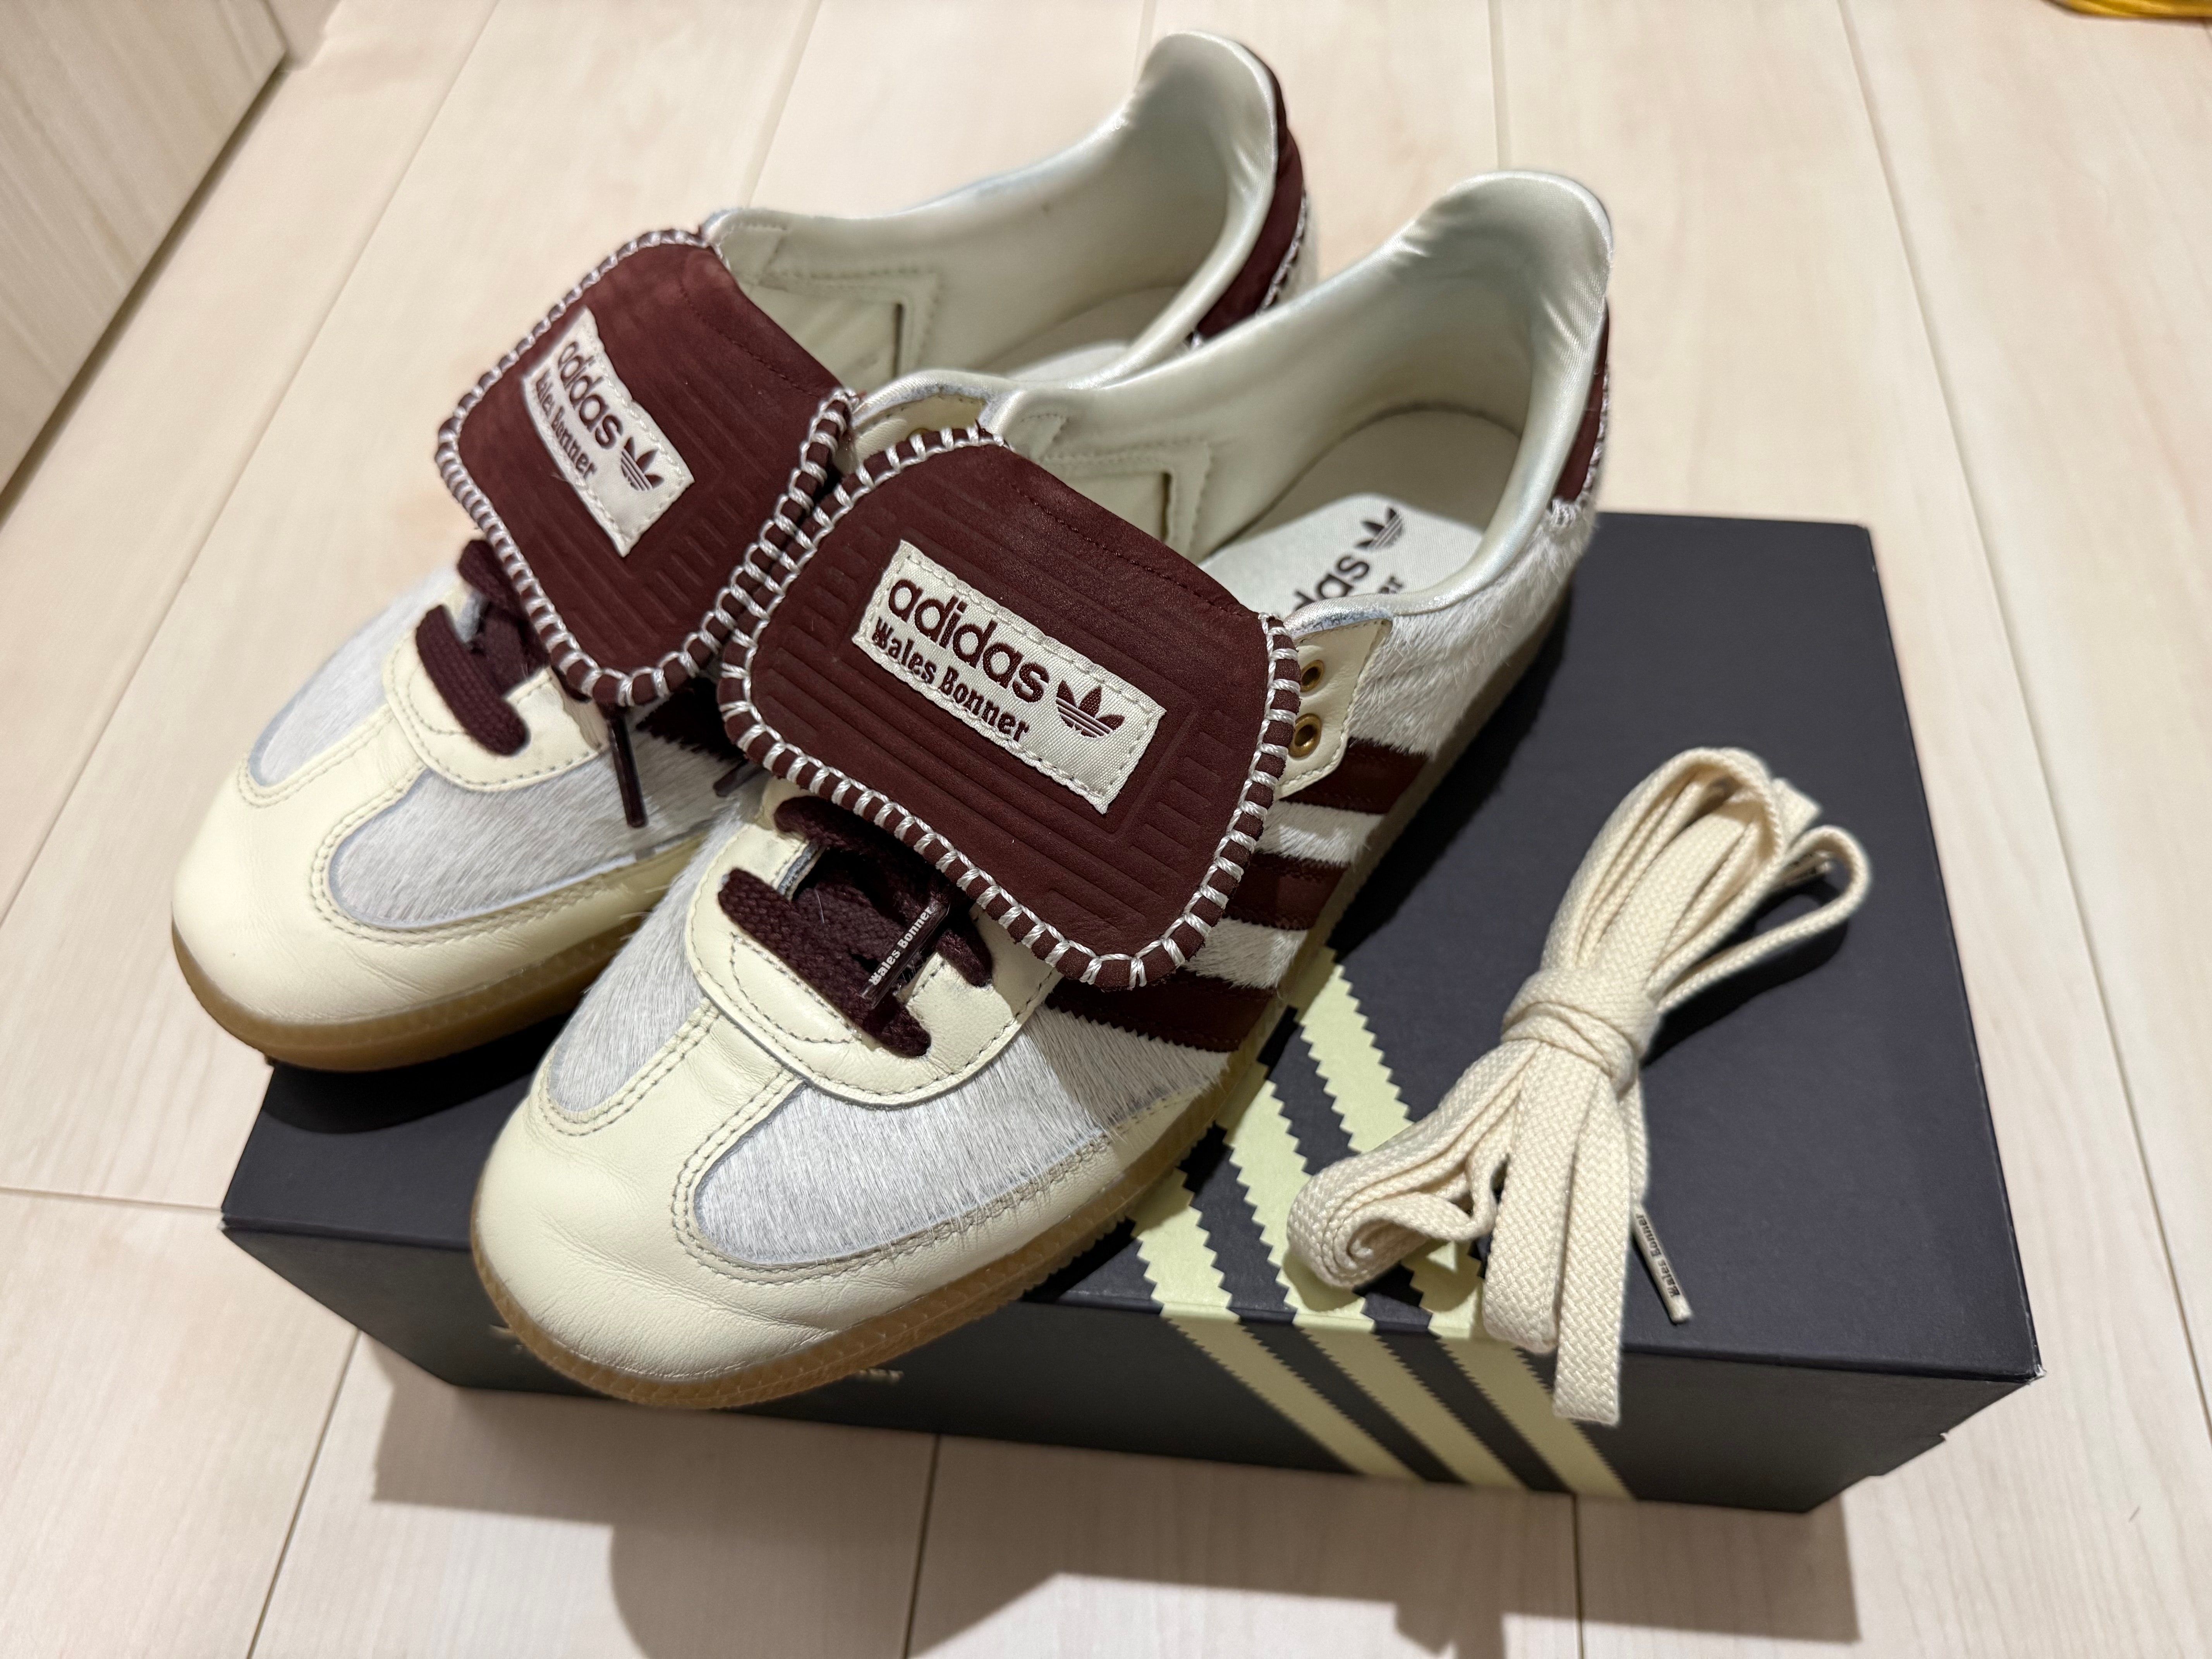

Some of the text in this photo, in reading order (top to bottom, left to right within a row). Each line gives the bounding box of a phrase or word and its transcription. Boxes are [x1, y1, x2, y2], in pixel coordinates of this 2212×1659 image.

[551, 406, 596, 479] Bonner
[558, 341, 623, 450] adidas
[872, 617, 1030, 742] Wales Bonner
[888, 578, 1050, 703] adidas
[869, 907, 934, 986] Wales Bonner
